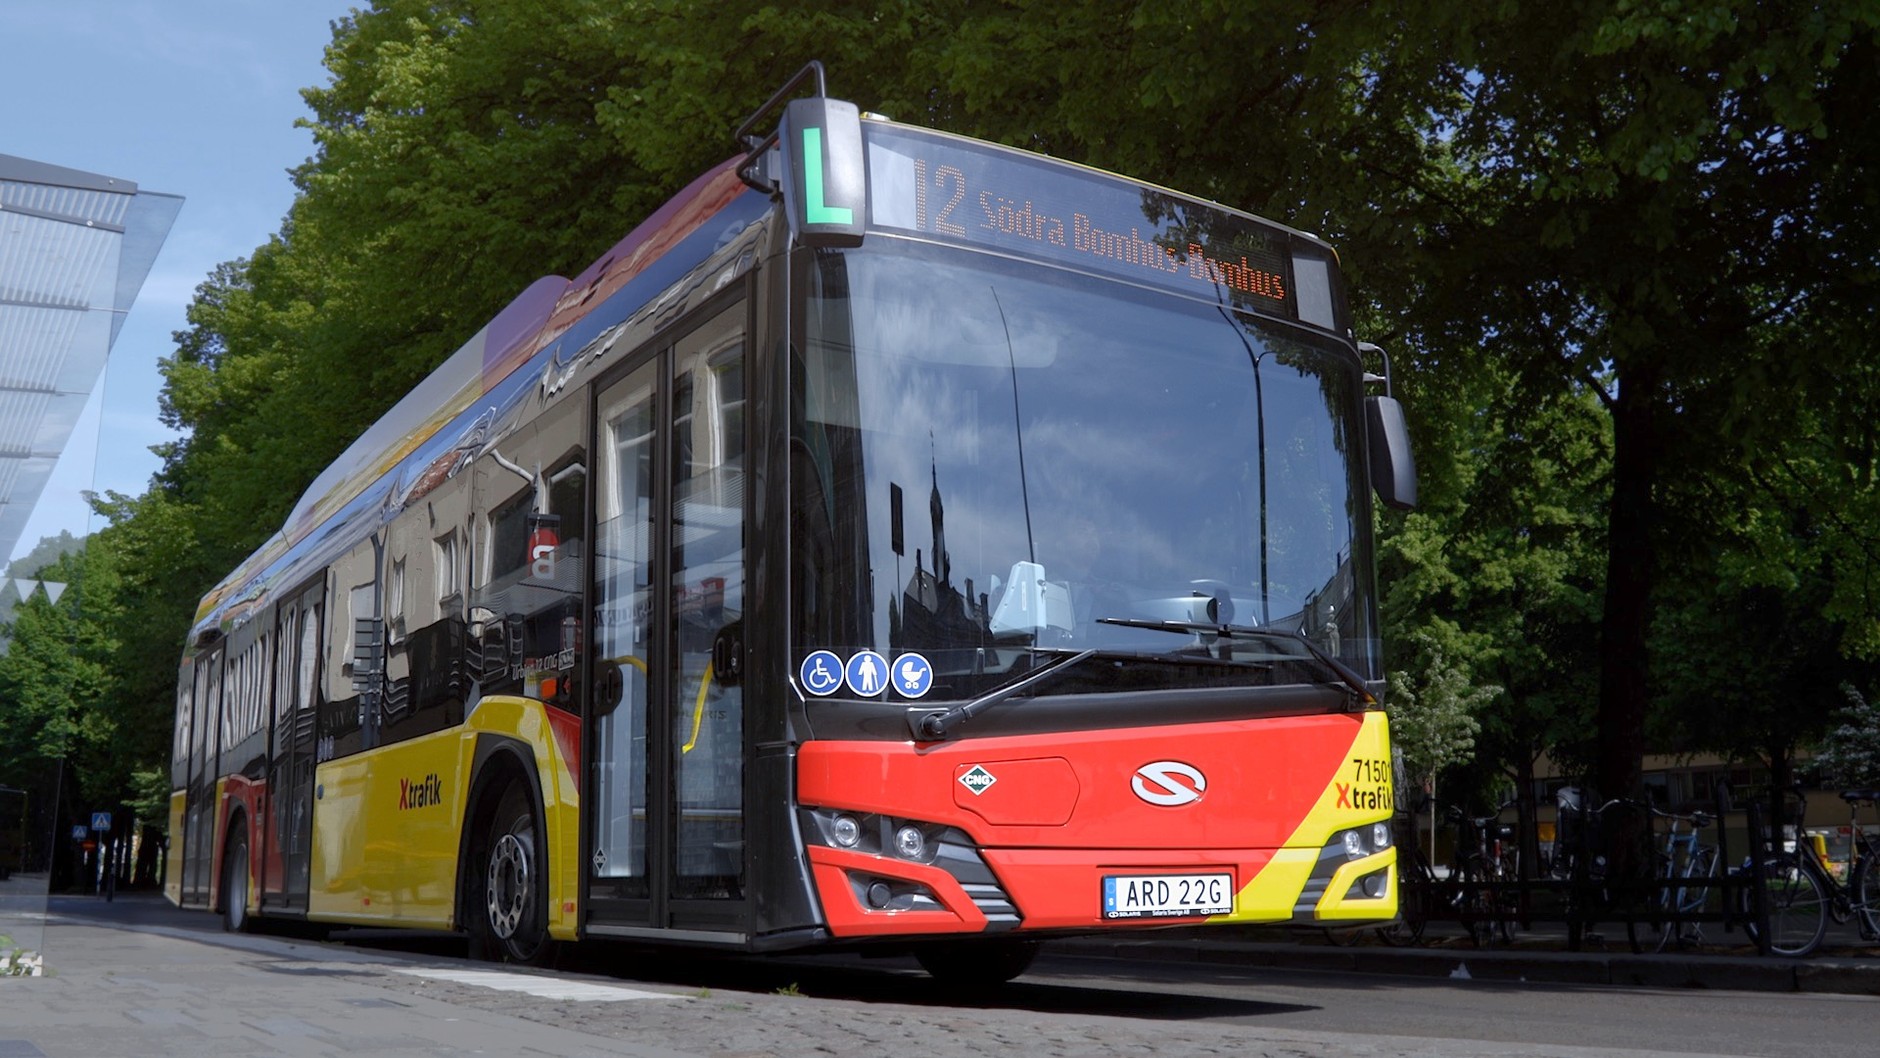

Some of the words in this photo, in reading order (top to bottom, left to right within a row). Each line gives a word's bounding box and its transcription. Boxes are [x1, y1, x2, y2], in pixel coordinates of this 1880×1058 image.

[803, 127, 854, 225] L
[912, 157, 967, 238] 12
[979, 189, 1065, 247] Södra
[399, 773, 442, 811] Xtrafik
[965, 774, 991, 786] CNG
[1335, 782, 1393, 810] Xtrafik
[1126, 880, 1170, 907] ARD
[1178, 879, 1221, 905] 22G
